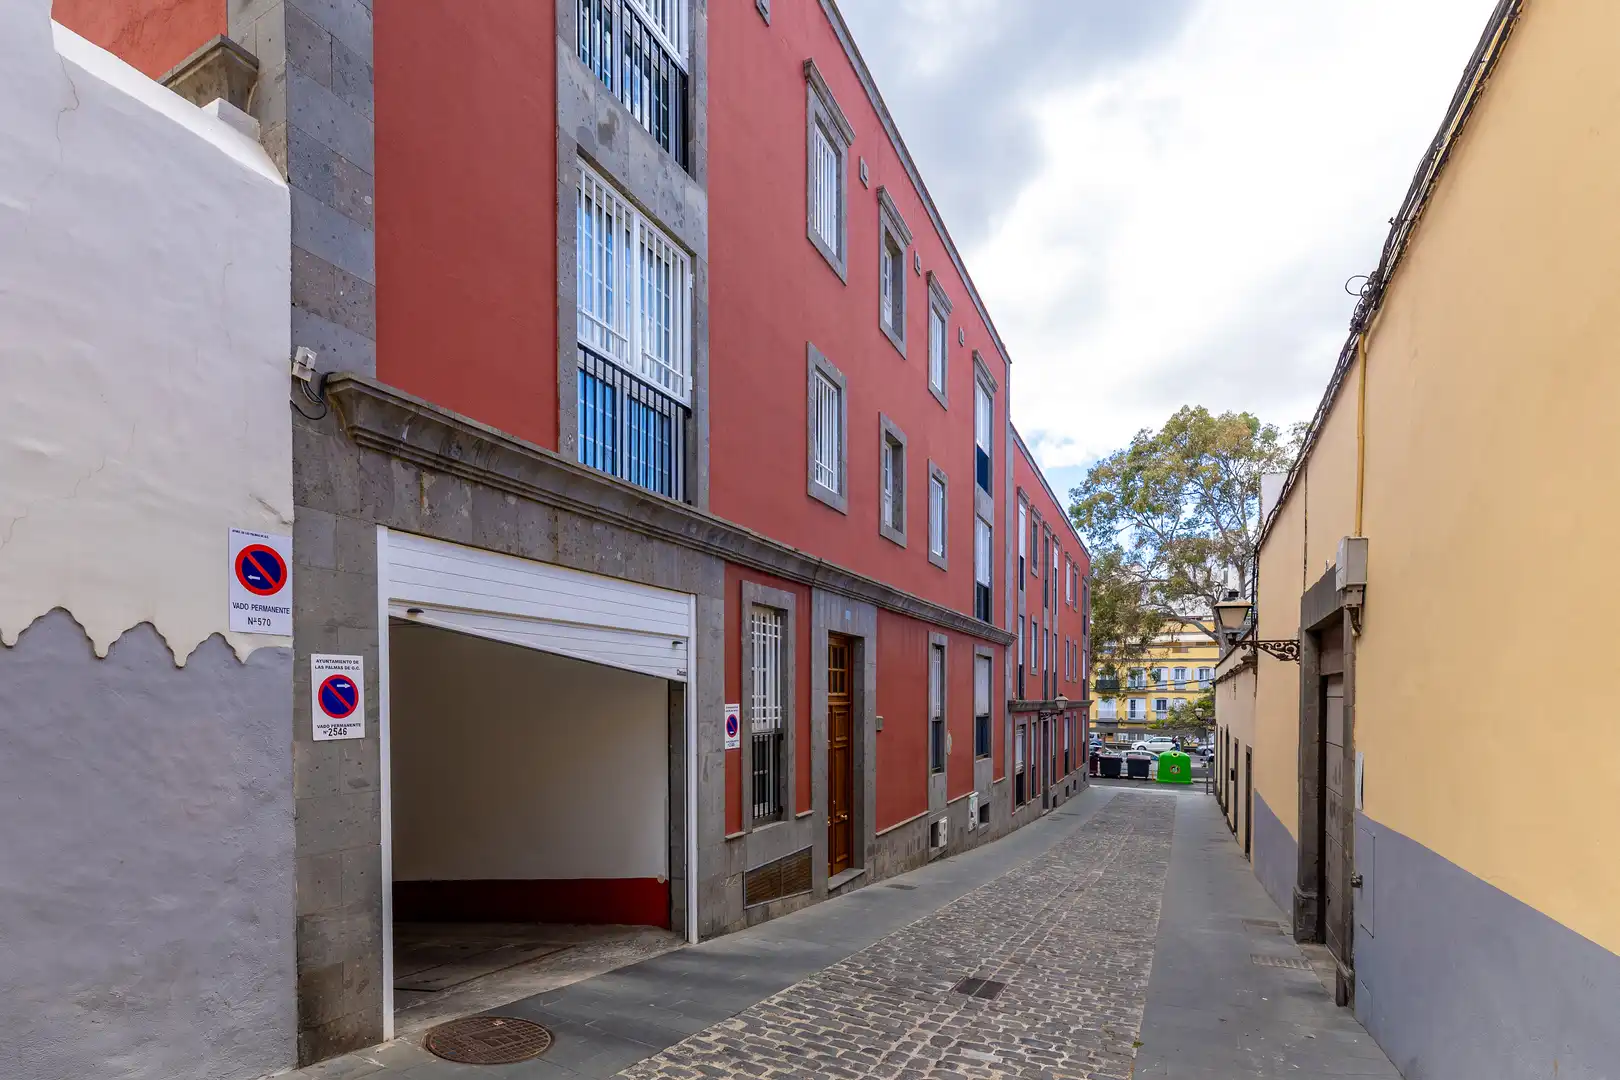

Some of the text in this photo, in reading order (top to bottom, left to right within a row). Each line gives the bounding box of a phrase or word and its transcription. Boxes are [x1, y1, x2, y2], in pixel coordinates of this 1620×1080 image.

[232, 601, 290, 614] VADO PERMANENTE
[328, 727, 347, 736] 2546
